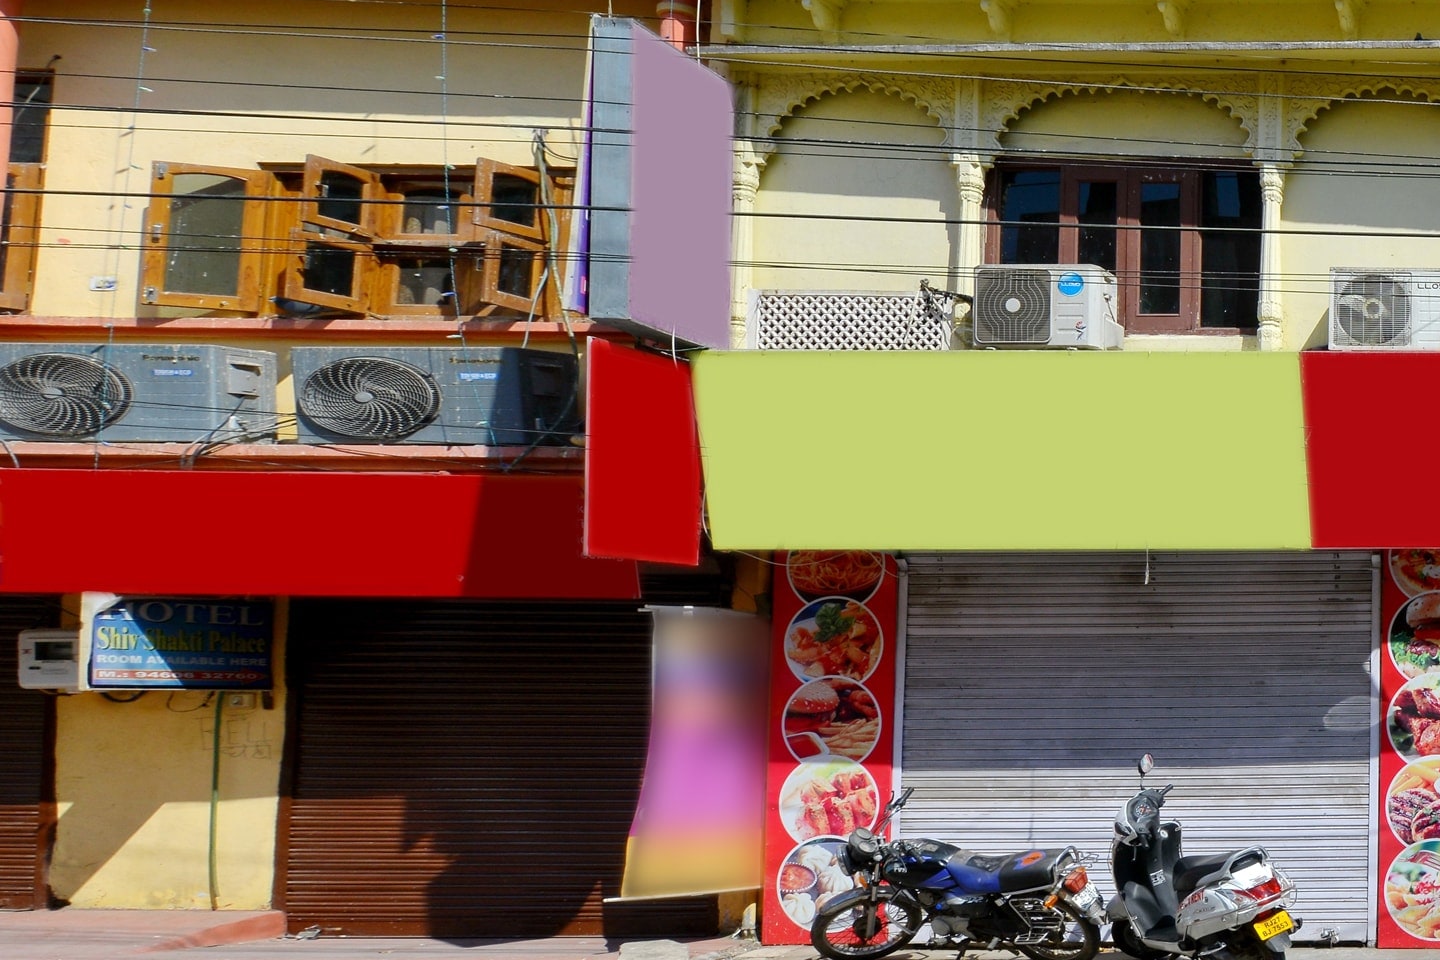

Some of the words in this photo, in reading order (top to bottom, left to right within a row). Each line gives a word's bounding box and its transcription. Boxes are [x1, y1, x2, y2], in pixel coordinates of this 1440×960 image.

[98, 601, 264, 626] HOTEL
[96, 626, 140, 651] Shiv
[143, 627, 205, 653] Shakti
[209, 630, 266, 654] Palace
[96, 654, 143, 665] ROOM
[146, 655, 226, 667] AVAILABLE
[229, 657, 268, 667] HERE
[1264, 916, 1281, 929] RJ27
